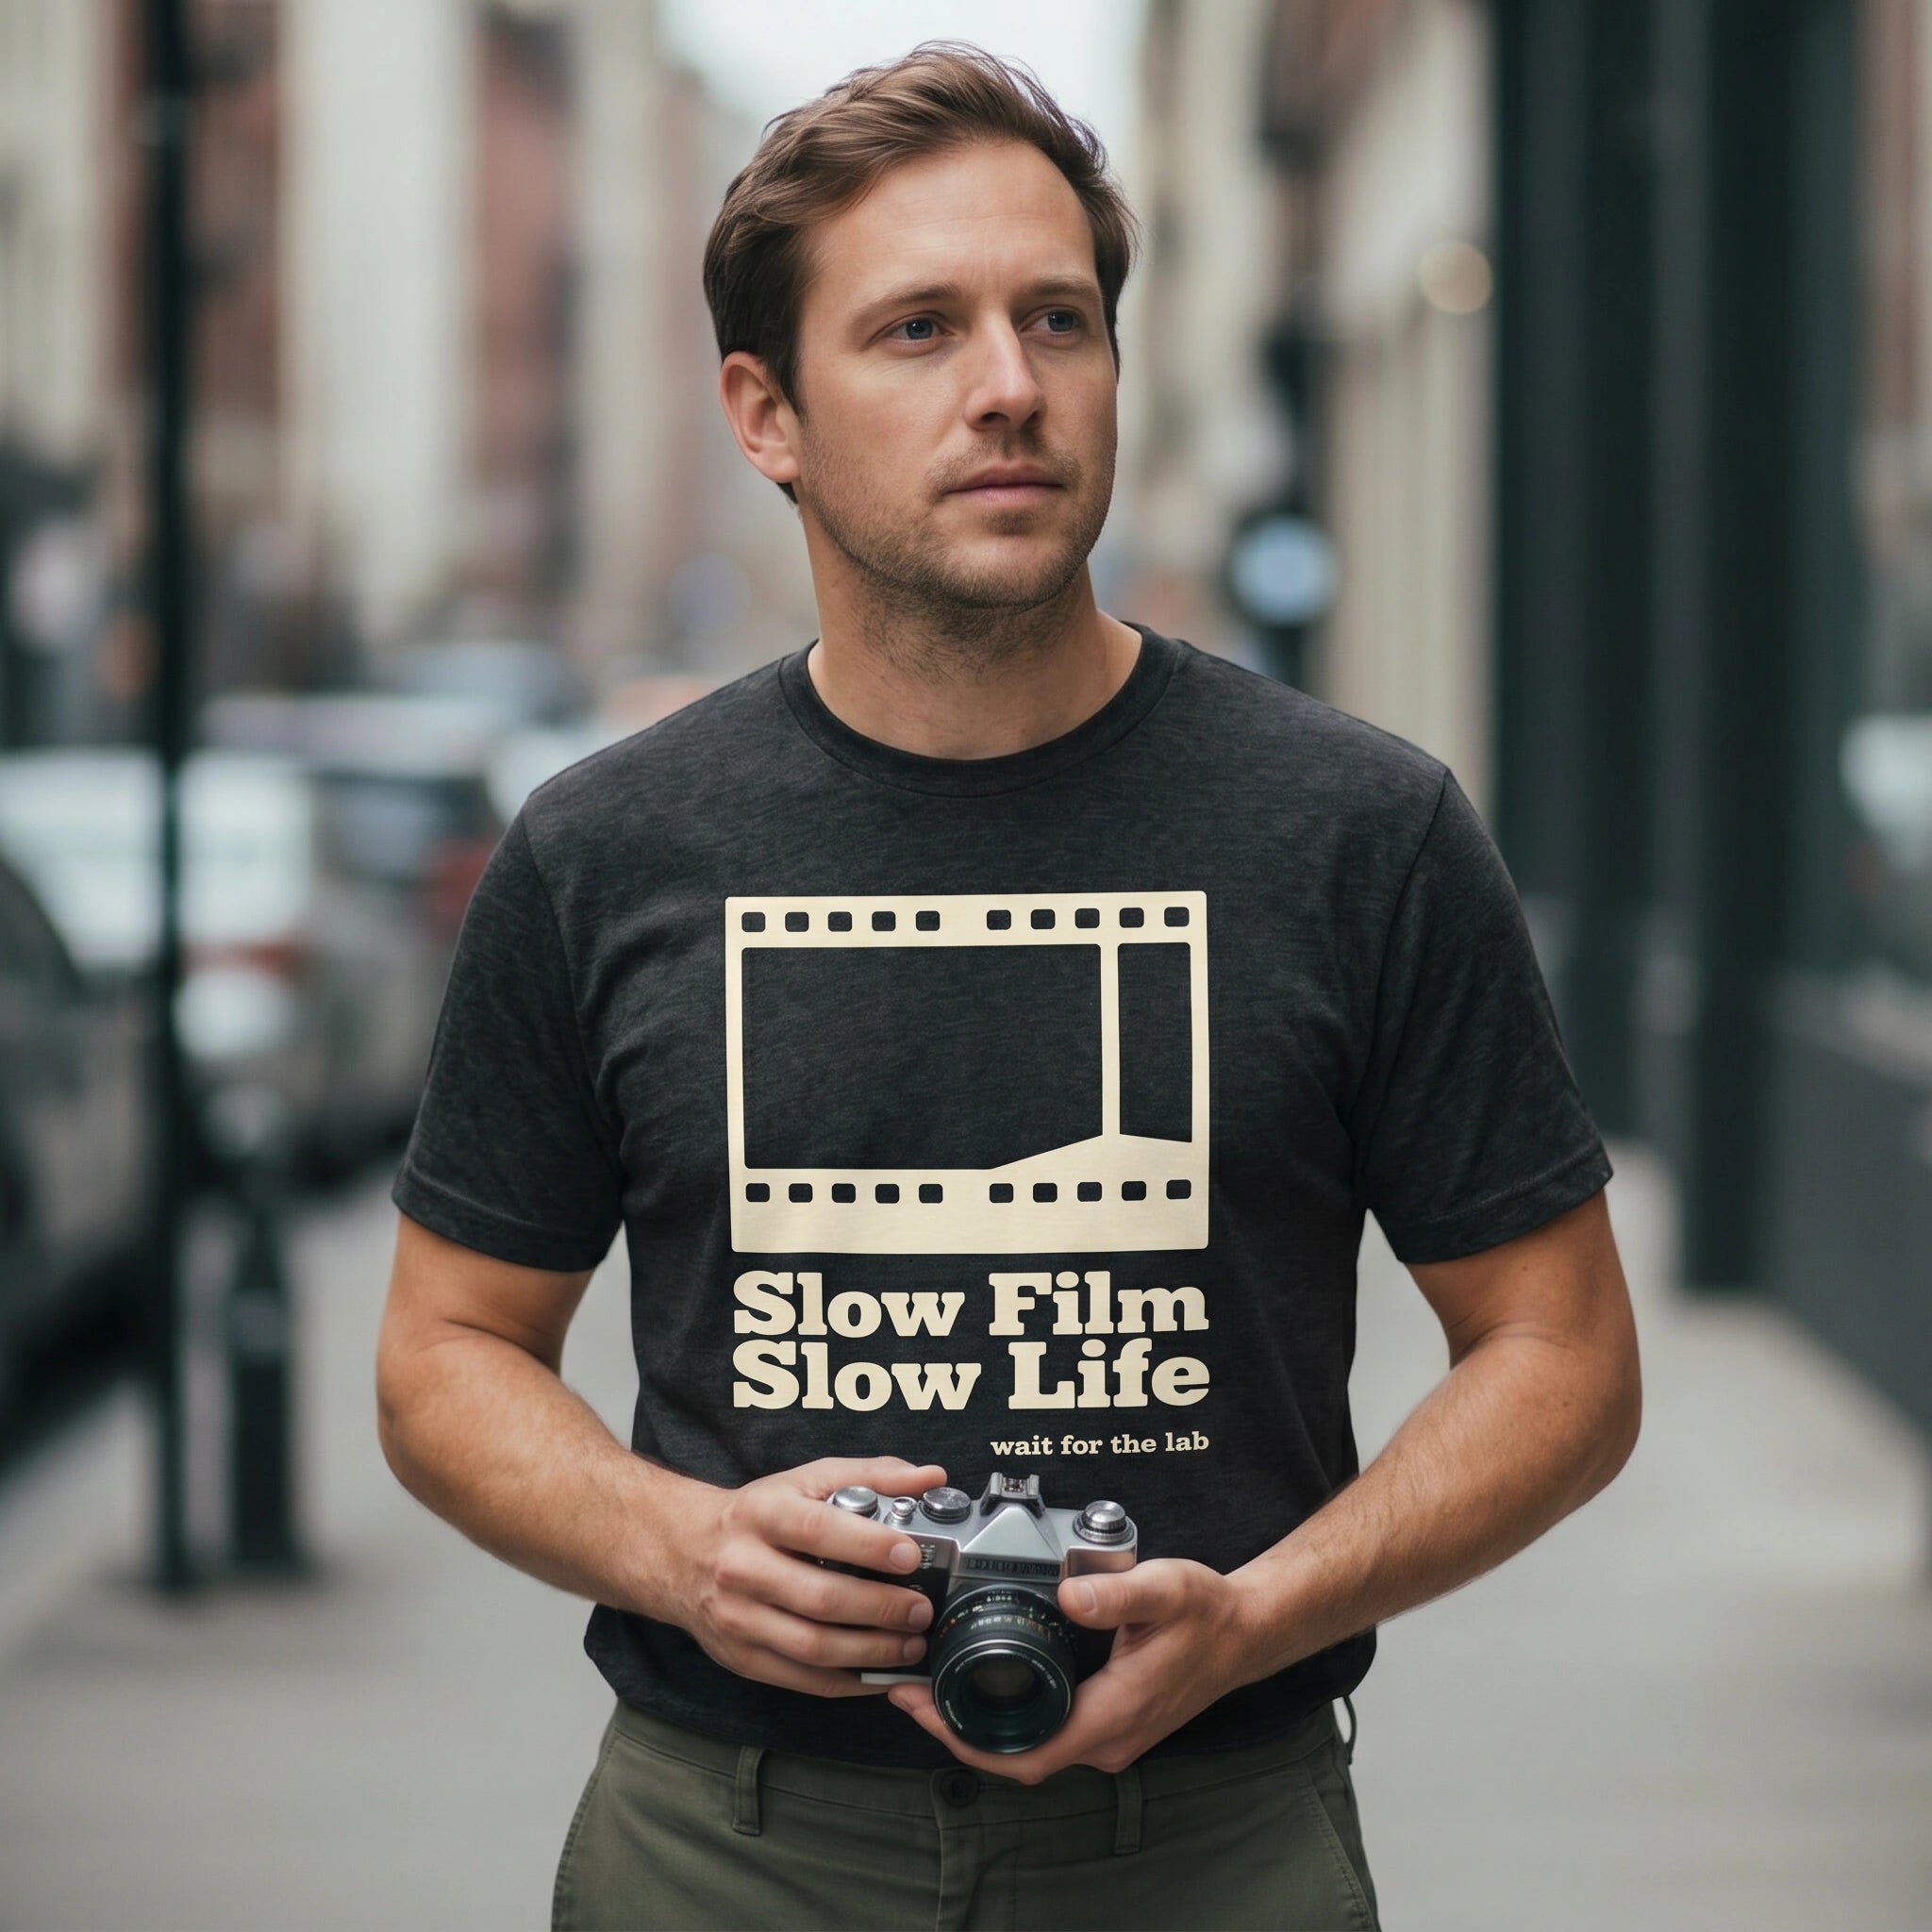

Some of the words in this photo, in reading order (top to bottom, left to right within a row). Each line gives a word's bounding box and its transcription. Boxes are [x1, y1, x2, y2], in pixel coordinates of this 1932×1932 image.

[734, 1271, 965, 1338] Slow
[989, 1271, 1209, 1336] Film
[732, 1340, 982, 1411] Slow
[1008, 1339, 1210, 1409] Life
[991, 1435, 1053, 1455] wait
[1061, 1435, 1103, 1455] for
[1110, 1434, 1157, 1454] the
[1165, 1431, 1209, 1452] lab
